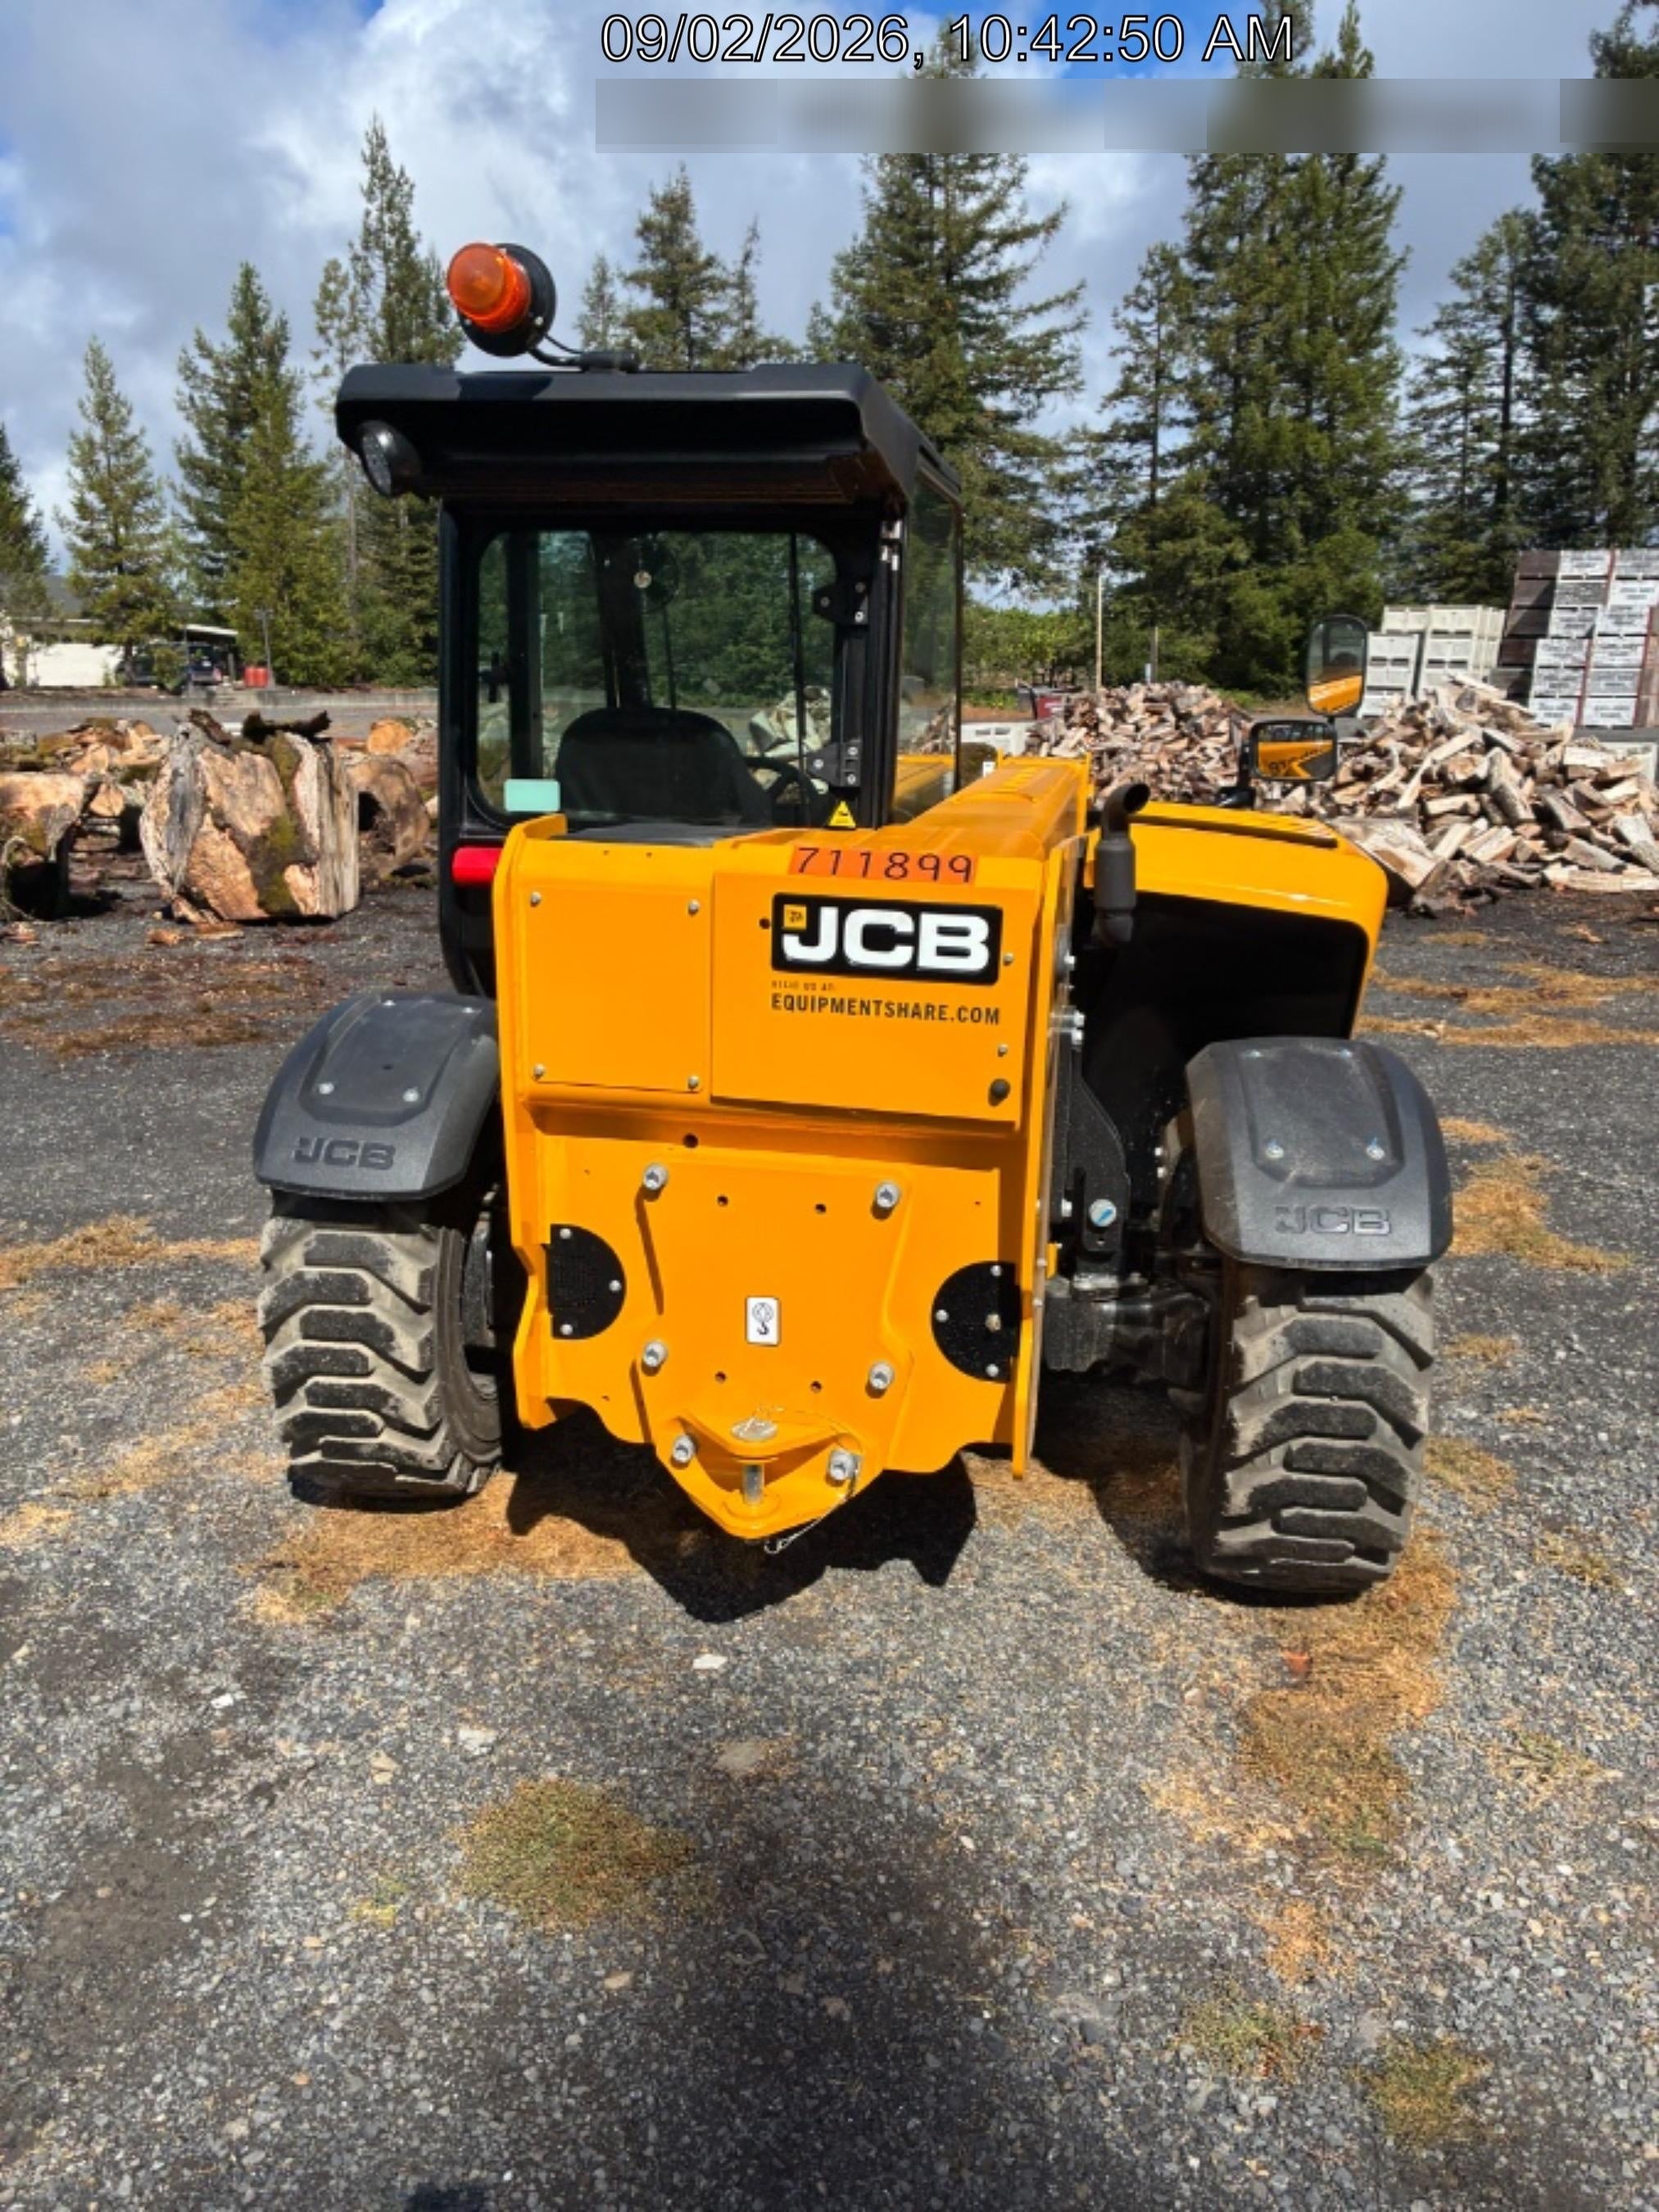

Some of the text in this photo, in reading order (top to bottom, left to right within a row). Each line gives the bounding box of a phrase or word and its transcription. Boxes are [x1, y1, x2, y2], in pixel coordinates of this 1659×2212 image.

[796, 847, 973, 883] 711899
[782, 905, 990, 972] JCB
[771, 993, 999, 1025] EQUIPMENTSHARE.COM
[292, 1137, 396, 1170] JCB
[1275, 1207, 1390, 1235] JCB
